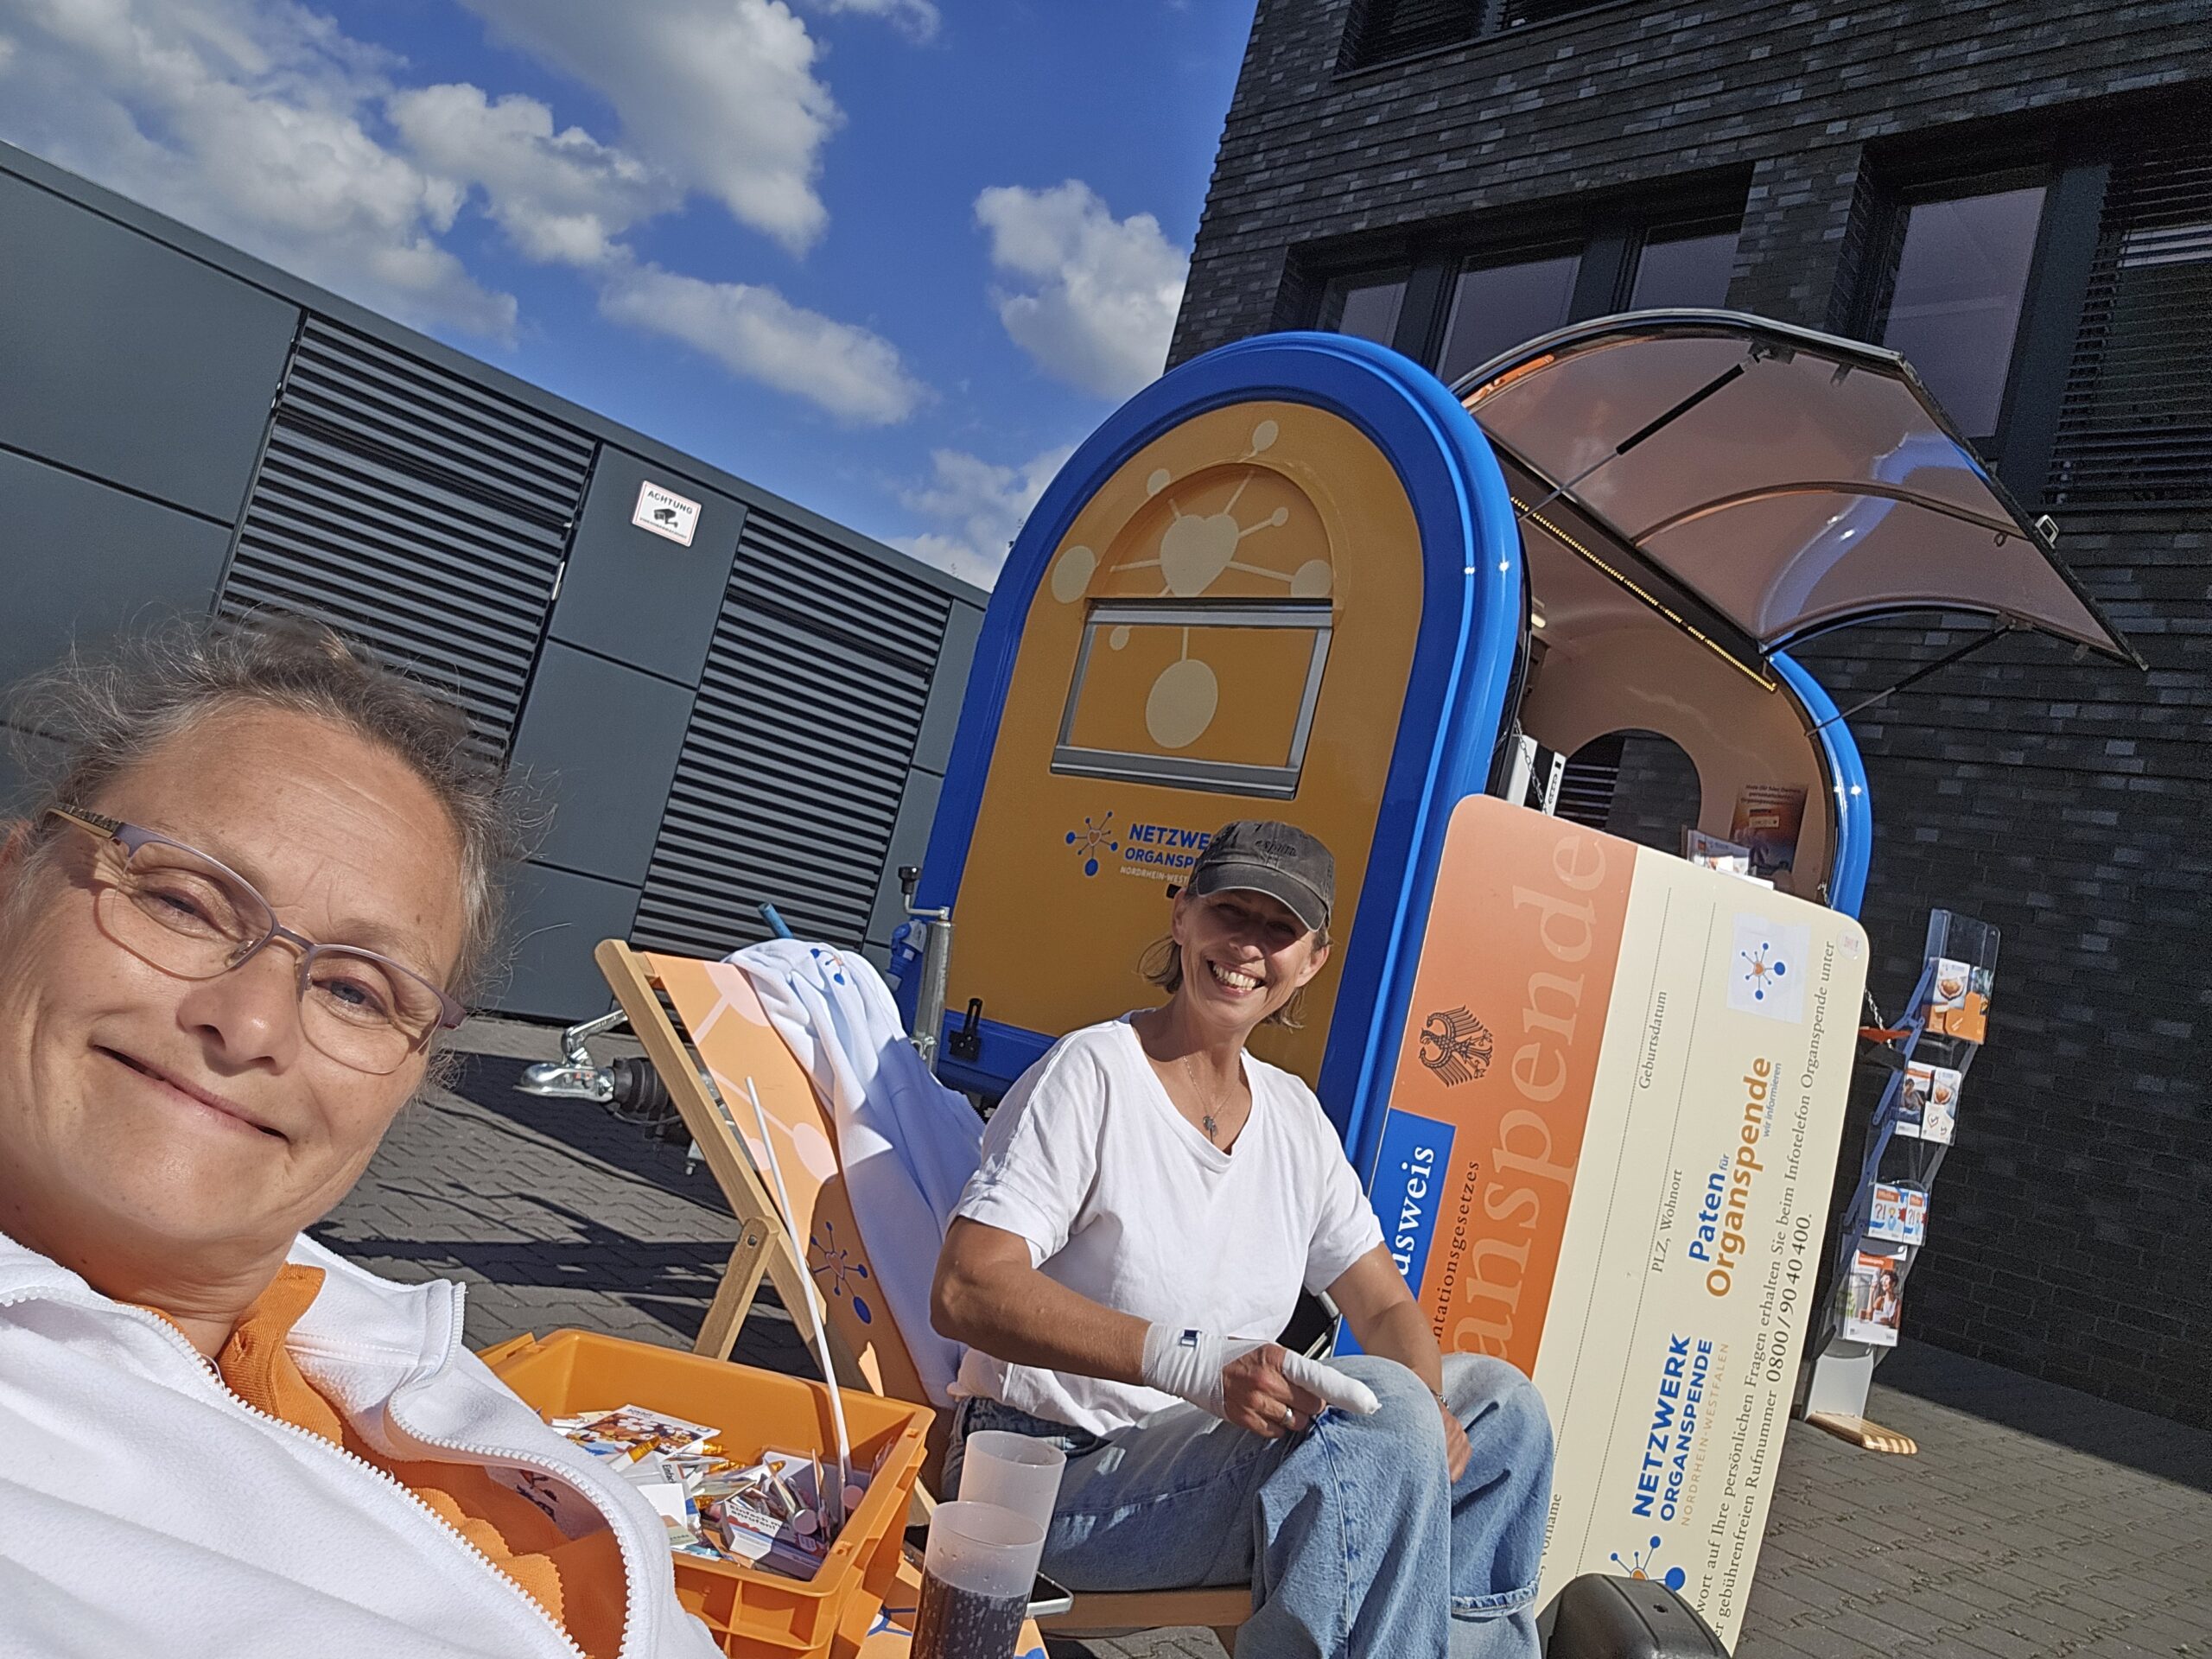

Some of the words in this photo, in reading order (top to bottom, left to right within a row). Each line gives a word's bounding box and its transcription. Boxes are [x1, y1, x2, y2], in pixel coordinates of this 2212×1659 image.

[647, 490, 693, 515] ACHTUNG
[1125, 848, 1194, 869] ORGANSP
[1128, 823, 1211, 850] NETZWE
[1120, 866, 1189, 884] NORDRHEIN-WEST
[1821, 941, 1835, 982] unter
[1638, 991, 1667, 1090] Geburtsdatum
[1801, 987, 1828, 1089] Organspende
[1452, 835, 1606, 1360] anspende
[1766, 1063, 1782, 1121] informieren
[1764, 1122, 1772, 1138] wir
[1783, 1095, 1811, 1182] Infotelefon
[1660, 1168, 1682, 1231] Wohnort
[1688, 1173, 1726, 1262] Paten
[1719, 1154, 1730, 1171] für
[1706, 1058, 1771, 1297] Organspende
[1776, 1187, 1795, 1226] beim
[1392, 1146, 1434, 1276] usweis
[1433, 1160, 1479, 1340] ntationsgesetzes
[1651, 1237, 1671, 1273] PLZ,
[1771, 1231, 1786, 1255] Sie
[1759, 1261, 1781, 1327] erhalten
[1744, 1332, 1767, 1389] Fragen
[1631, 1333, 1691, 1518] NETZWERK
[1661, 1338, 1713, 1522] ORGANSPENDE
[1681, 1343, 1729, 1527] NORDRHEIN-WESTFALEN
[1724, 1394, 1754, 1498] persönlichen
[1745, 1389, 1777, 1490] Rufnummer
[1711, 1503, 1730, 1536] Ihre
[1707, 1539, 1721, 1569] auf
[1719, 1496, 1755, 1618] gebührenfreien
[1697, 1574, 1713, 1616] wort
[1714, 1622, 1725, 1638] er
